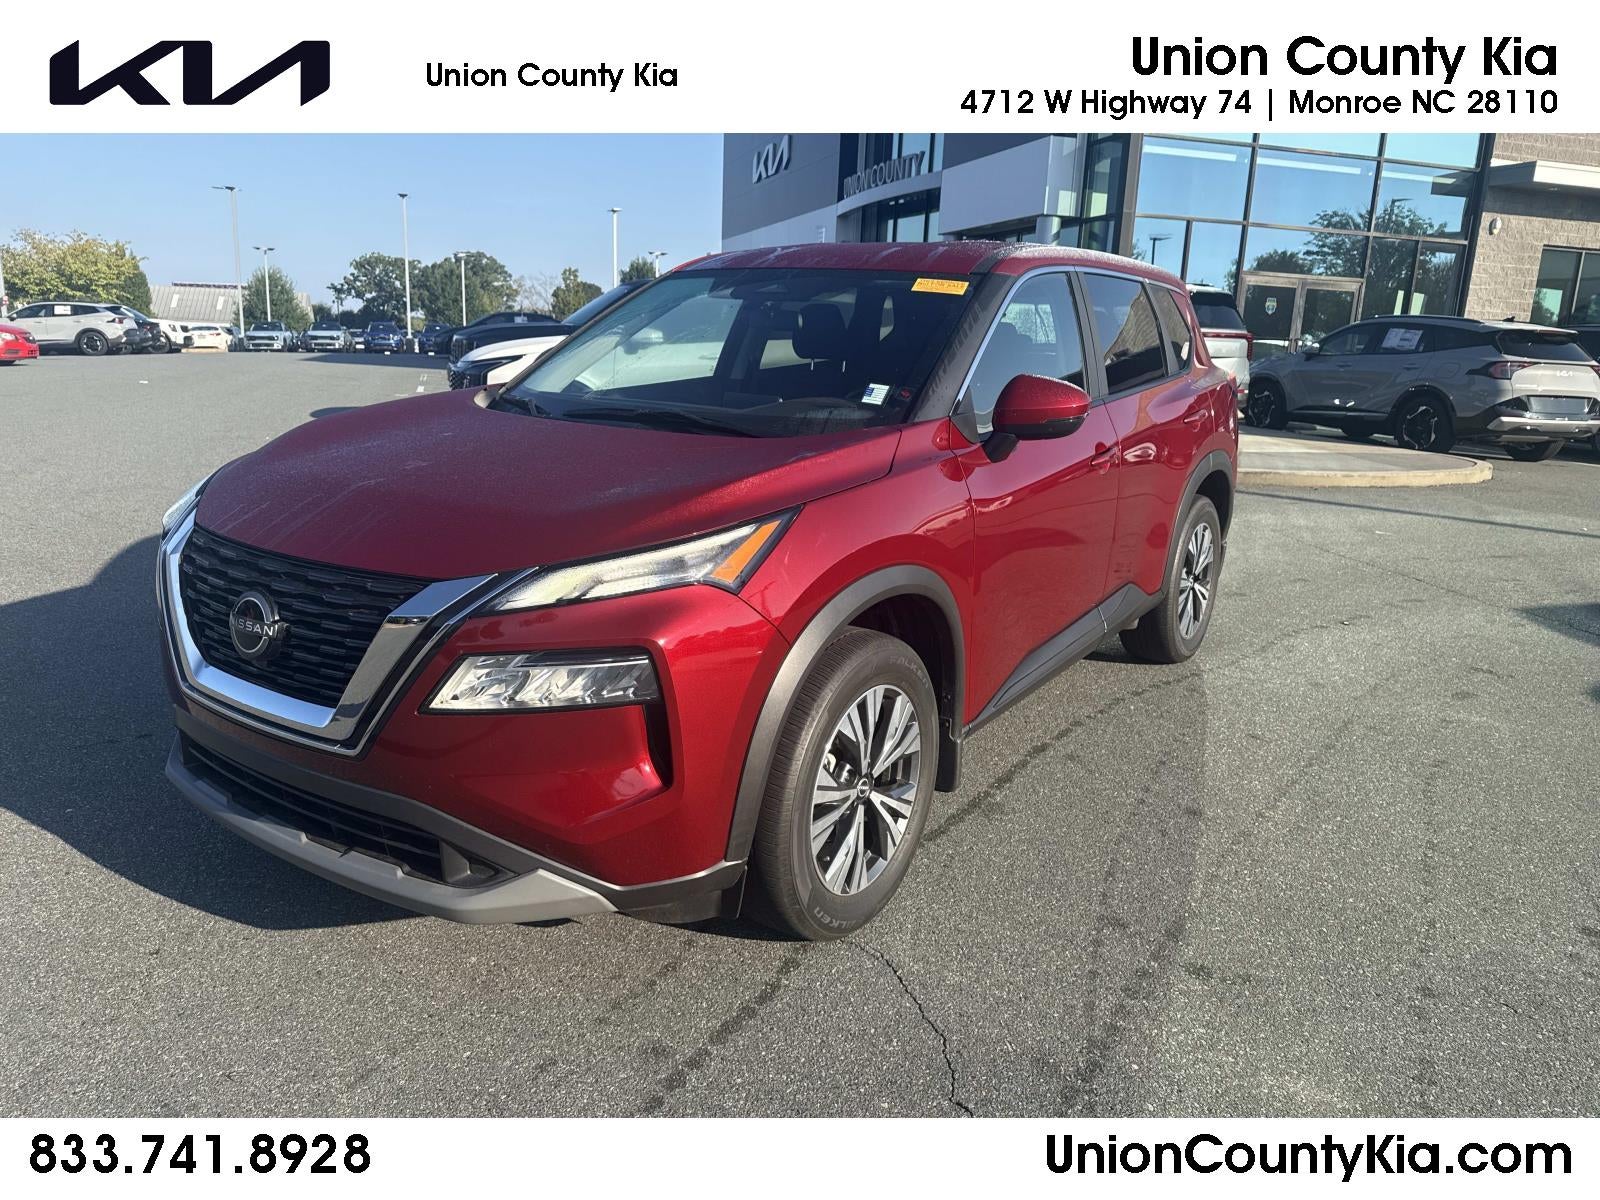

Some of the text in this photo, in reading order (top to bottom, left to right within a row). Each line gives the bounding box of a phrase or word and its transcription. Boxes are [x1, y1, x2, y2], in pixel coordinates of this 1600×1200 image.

[752, 134, 791, 184] KIA
[843, 151, 925, 199] UNION COUNTY
